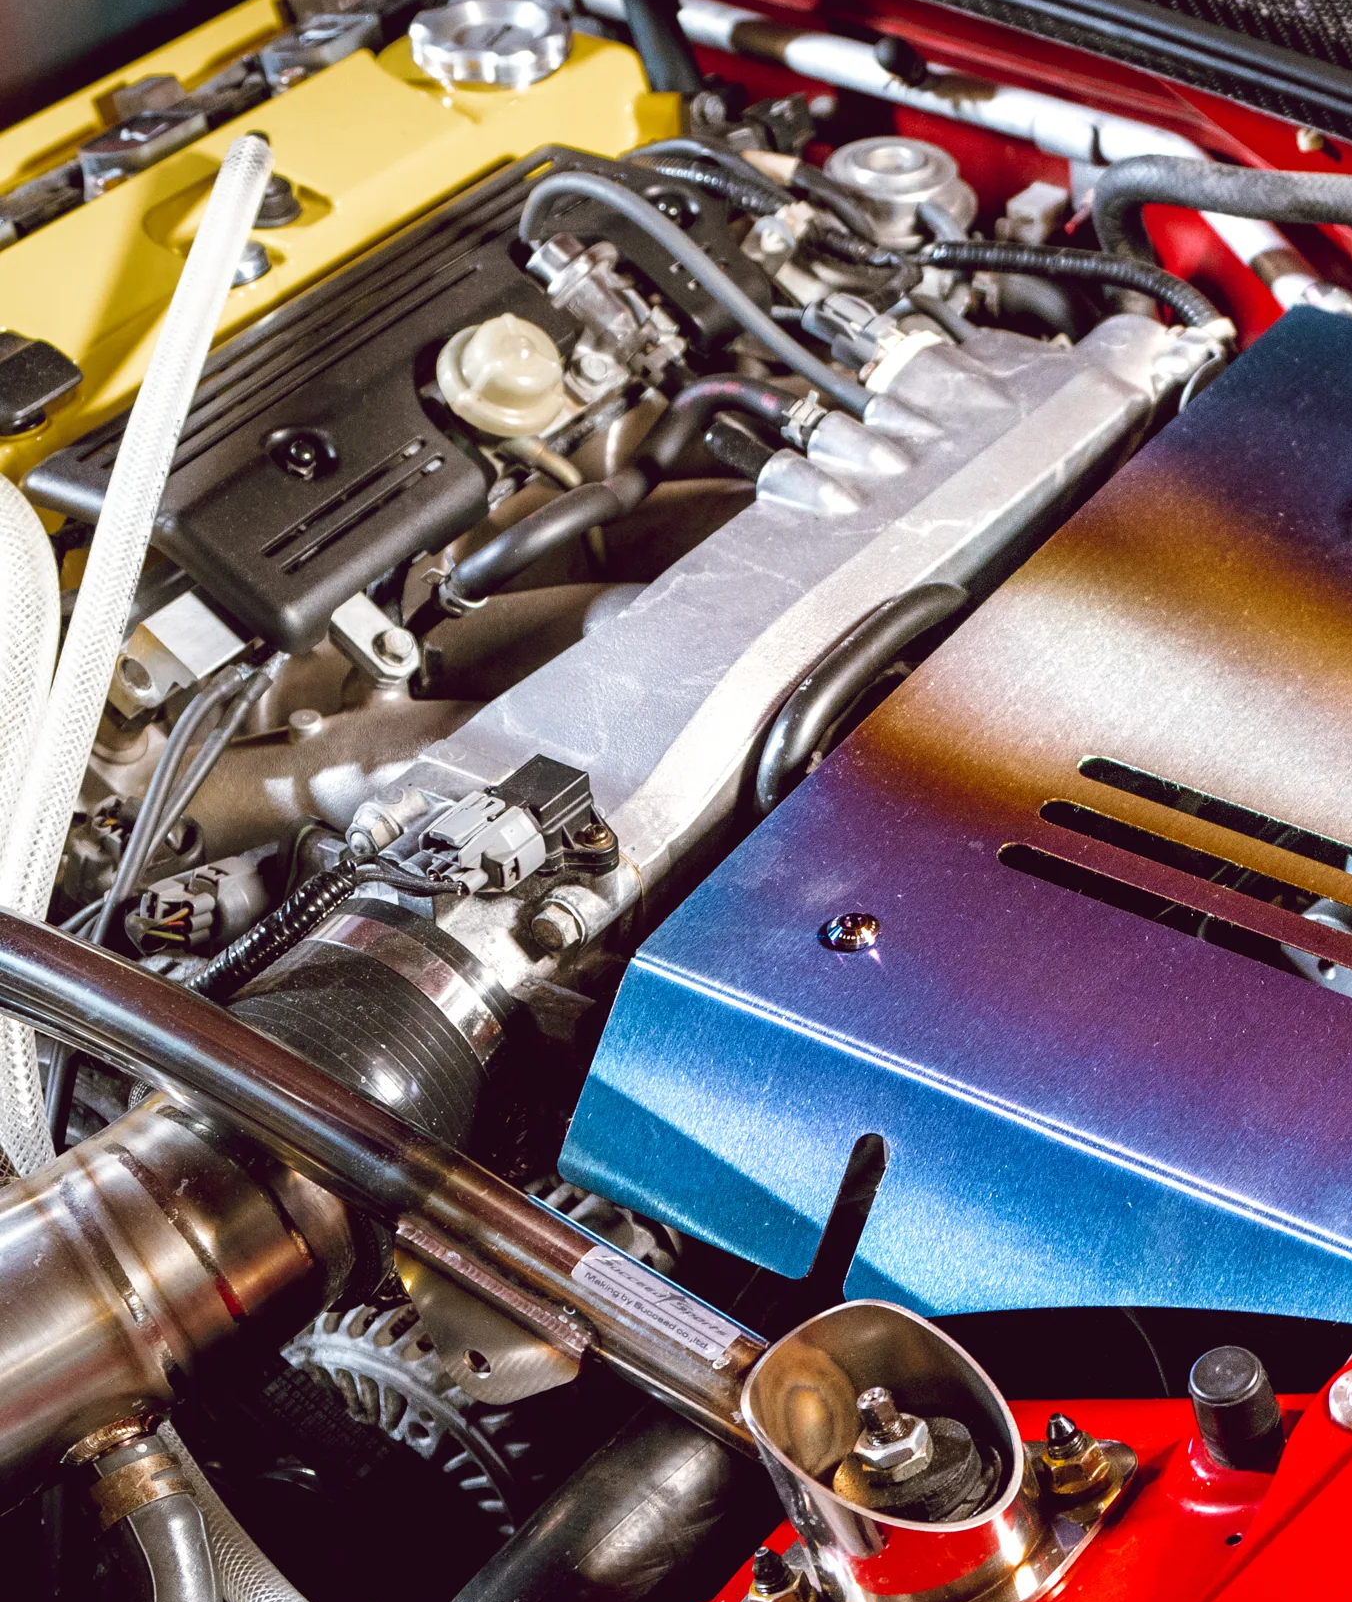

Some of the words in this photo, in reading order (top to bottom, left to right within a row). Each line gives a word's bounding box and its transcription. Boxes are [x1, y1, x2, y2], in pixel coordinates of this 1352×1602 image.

[584, 1271, 620, 1299] Making
[620, 1292, 632, 1306] by
[633, 1300, 677, 1331] Succeed
